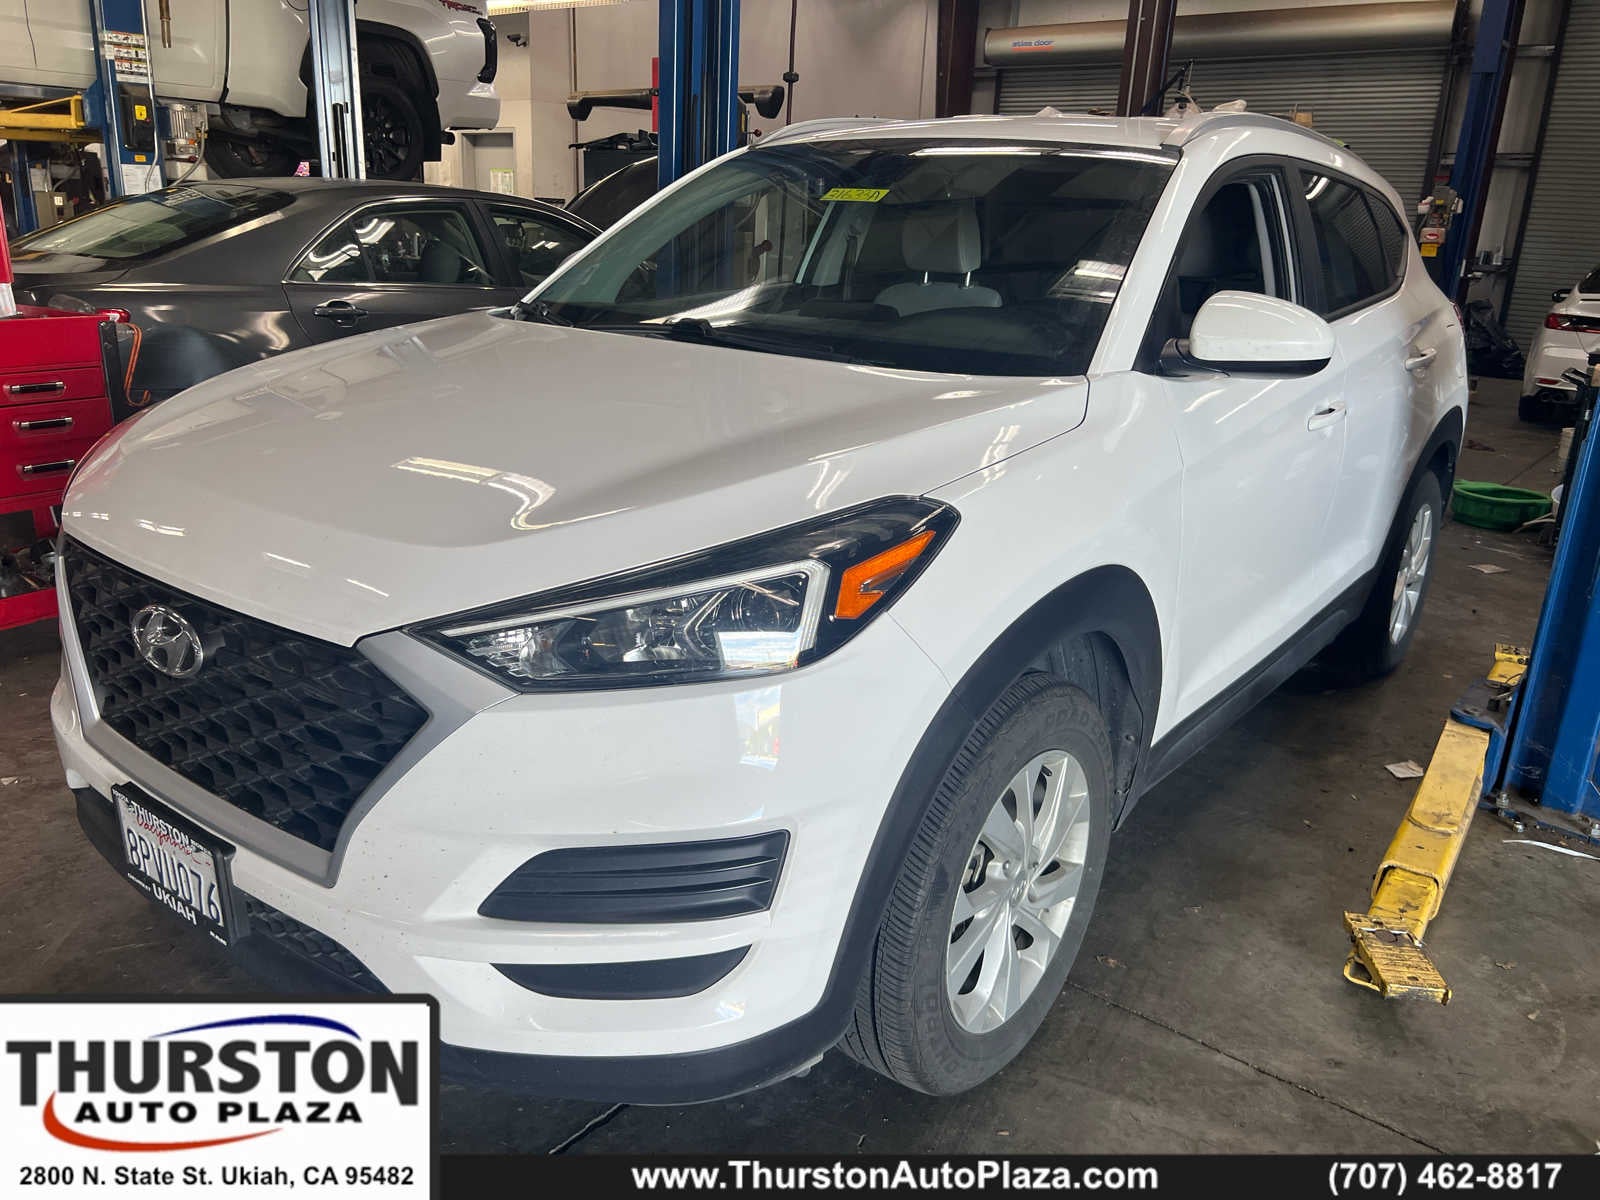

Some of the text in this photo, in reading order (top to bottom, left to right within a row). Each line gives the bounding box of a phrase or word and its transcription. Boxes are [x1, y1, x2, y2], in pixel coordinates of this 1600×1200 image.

[131, 800, 190, 846] THURSTON
[127, 828, 221, 924] 8PVU076
[152, 882, 197, 926] UKIAH
